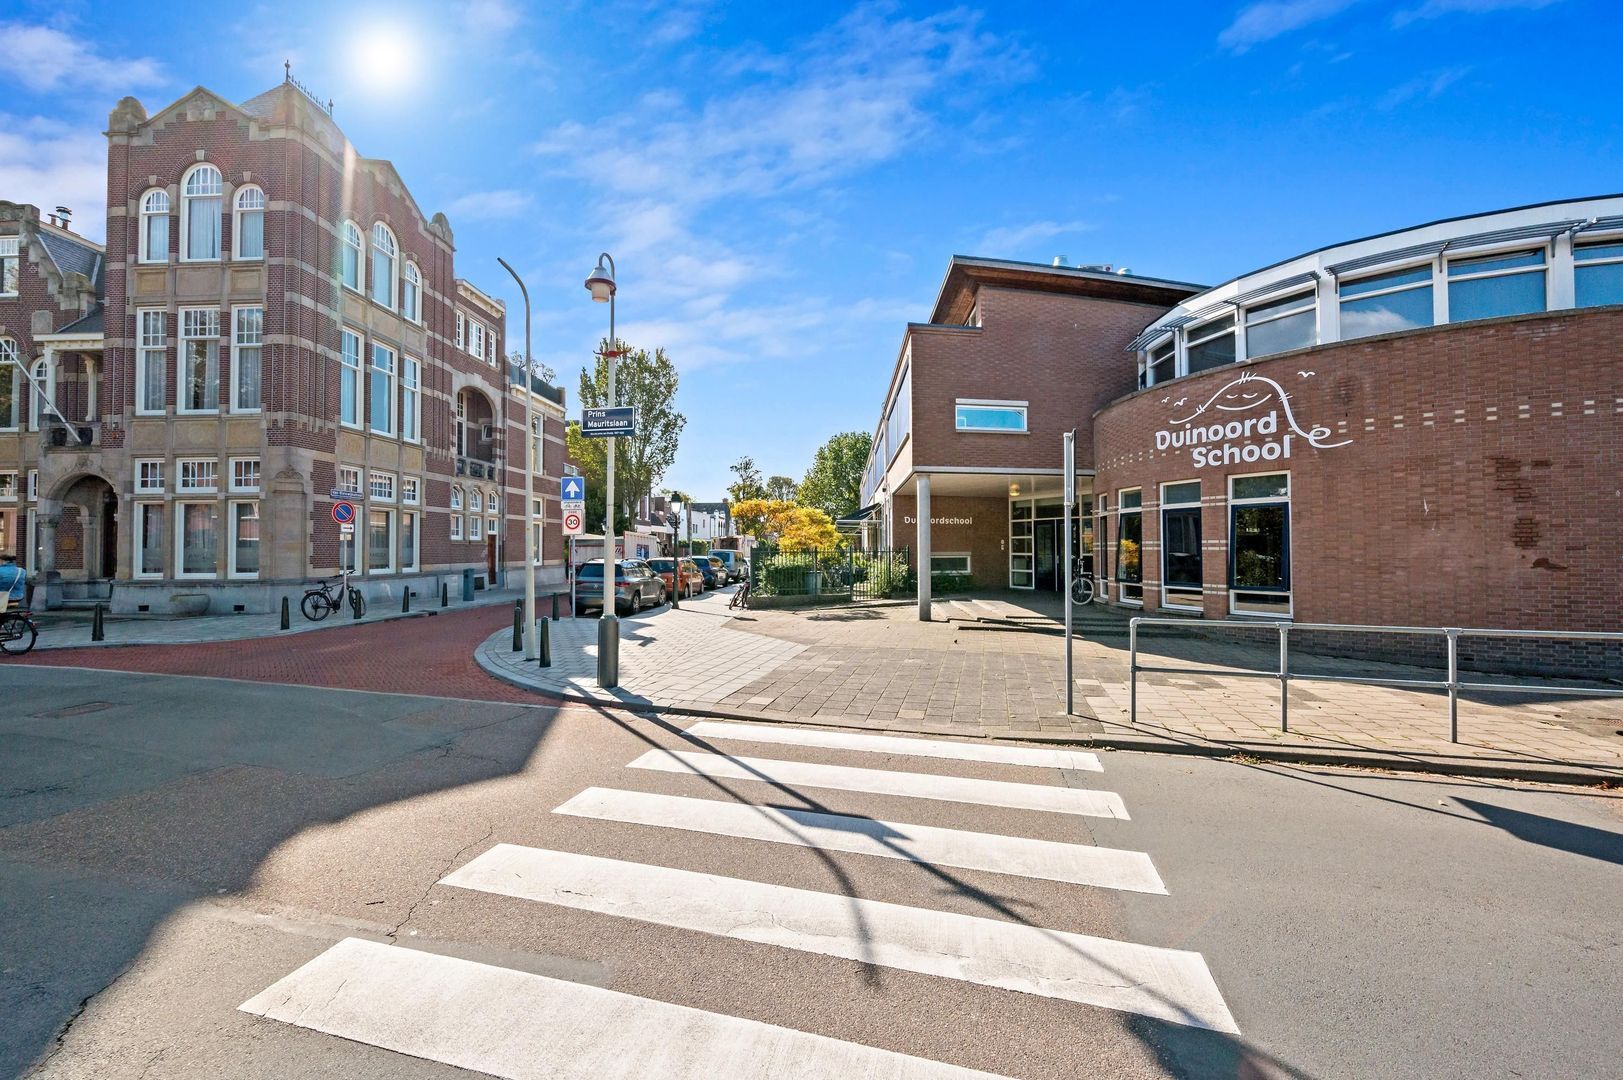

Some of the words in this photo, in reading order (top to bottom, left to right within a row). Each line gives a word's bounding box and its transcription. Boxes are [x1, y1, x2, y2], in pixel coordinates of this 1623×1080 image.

[587, 410, 606, 418] Prins
[587, 419, 628, 428] Mauritslaan
[1155, 410, 1277, 450] Duinoord
[1192, 435, 1291, 468] School
[904, 516, 973, 524] Duordschool
